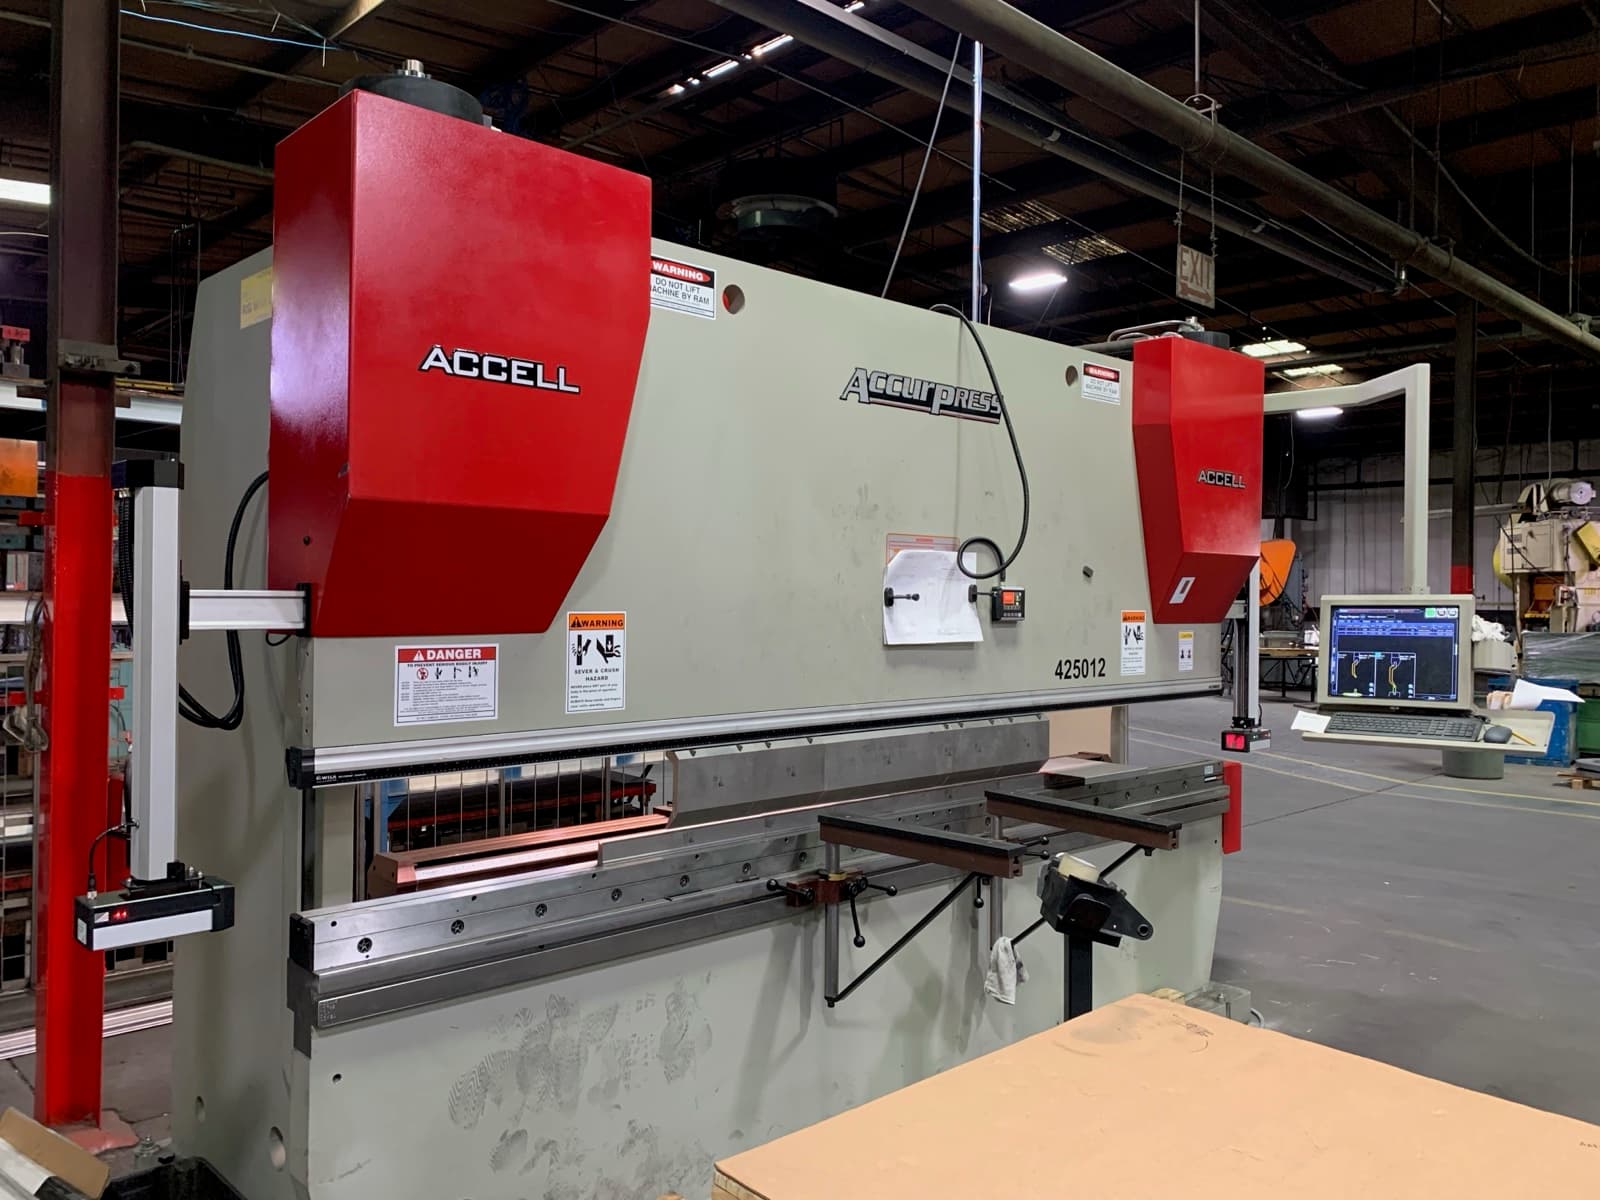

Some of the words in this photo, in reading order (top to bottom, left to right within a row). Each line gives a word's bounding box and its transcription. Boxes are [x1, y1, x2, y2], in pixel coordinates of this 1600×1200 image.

[652, 261, 704, 282] WARNING
[1180, 246, 1213, 290] EXIT
[652, 285, 680, 298] ACHINE
[681, 292, 692, 300] BY
[693, 294, 710, 305] RAM
[655, 277, 667, 285] DO
[668, 280, 683, 290] NOT
[685, 284, 700, 294] LIFT
[418, 345, 581, 394] ACCELL
[1198, 469, 1246, 489] ACCELL
[581, 619, 624, 628] WARNING
[426, 648, 482, 661] DANGER
[1055, 657, 1106, 680] 425012
